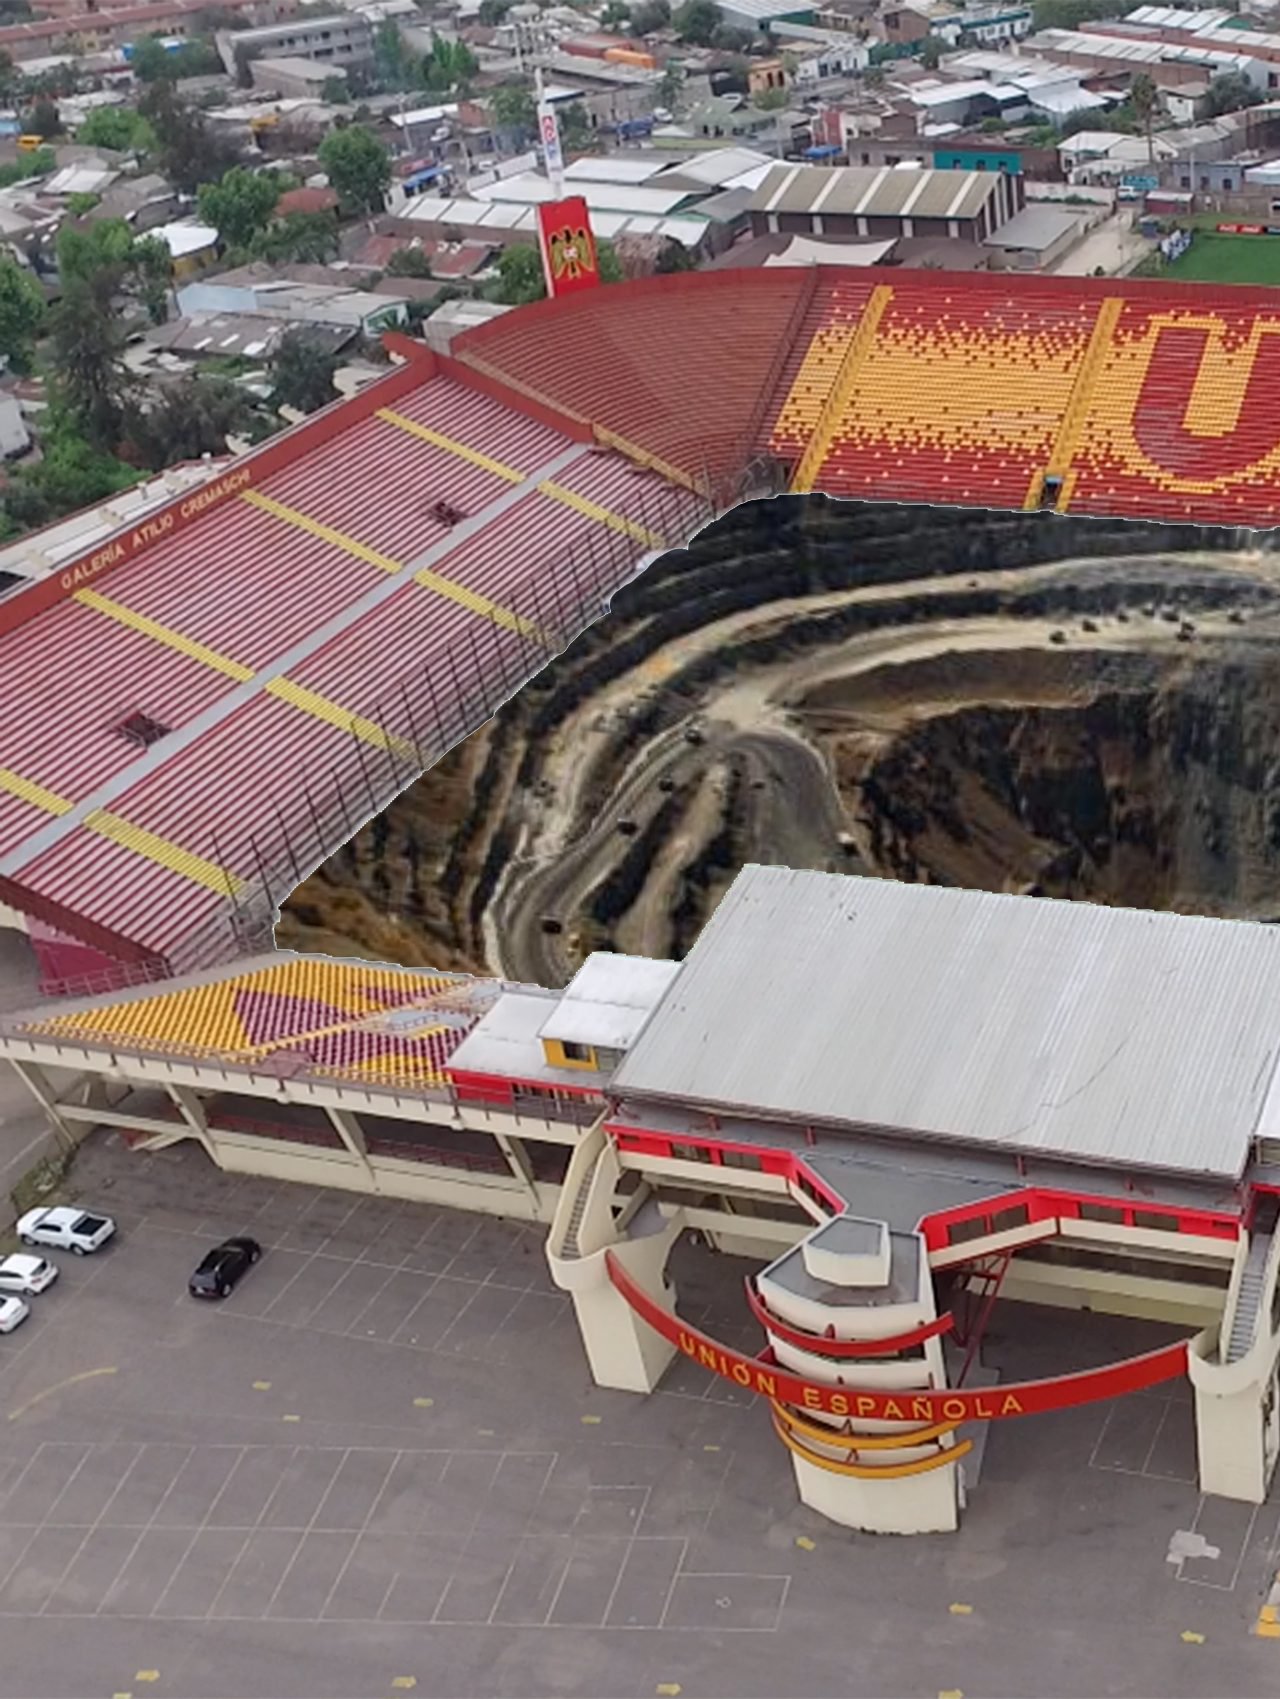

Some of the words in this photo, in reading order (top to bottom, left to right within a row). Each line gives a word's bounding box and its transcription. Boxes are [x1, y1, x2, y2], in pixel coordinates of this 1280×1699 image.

[132, 514, 174, 548] ATILIO
[180, 468, 250, 518] CREMASCHI
[678, 1331, 777, 1396] UNIÓN
[803, 1387, 1023, 1419] ESPAÑOLA
